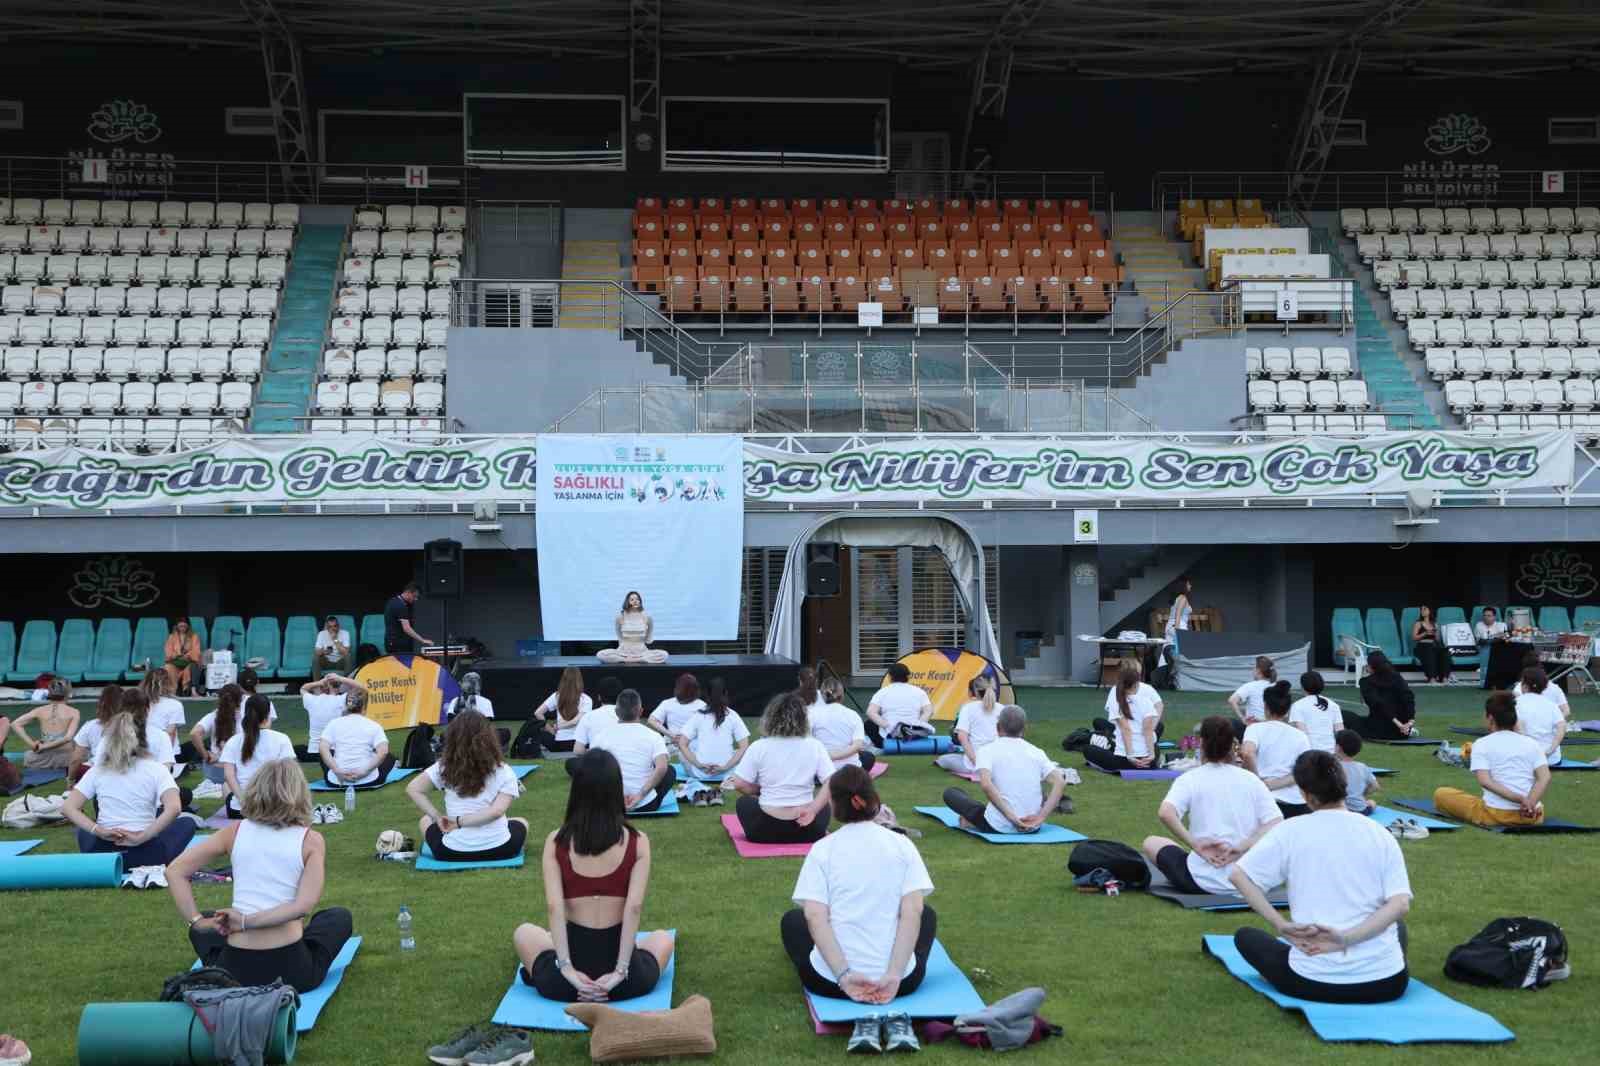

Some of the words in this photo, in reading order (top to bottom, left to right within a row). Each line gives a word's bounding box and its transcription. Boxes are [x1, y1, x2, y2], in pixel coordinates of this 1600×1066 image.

[68, 147, 176, 168] NİÜFER
[68, 169, 174, 184] BEDİYESİ
[410, 168, 424, 185] H
[1547, 173, 1559, 191] F
[1283, 300, 1291, 310] 6
[283, 448, 488, 497] Geldik
[1142, 447, 1254, 489] Sen
[1262, 446, 1376, 494] Çok
[1382, 440, 1539, 484] Yaşa
[553, 473, 624, 490] SAĞLIKLI
[554, 491, 602, 501] YAŞLANMA
[605, 490, 624, 502] İÇİN
[1081, 521, 1091, 534] 3
[367, 677, 388, 691] Spor
[391, 674, 417, 688] Kenti
[927, 670, 956, 681] Kenti
[369, 692, 404, 704] Nilüfer
